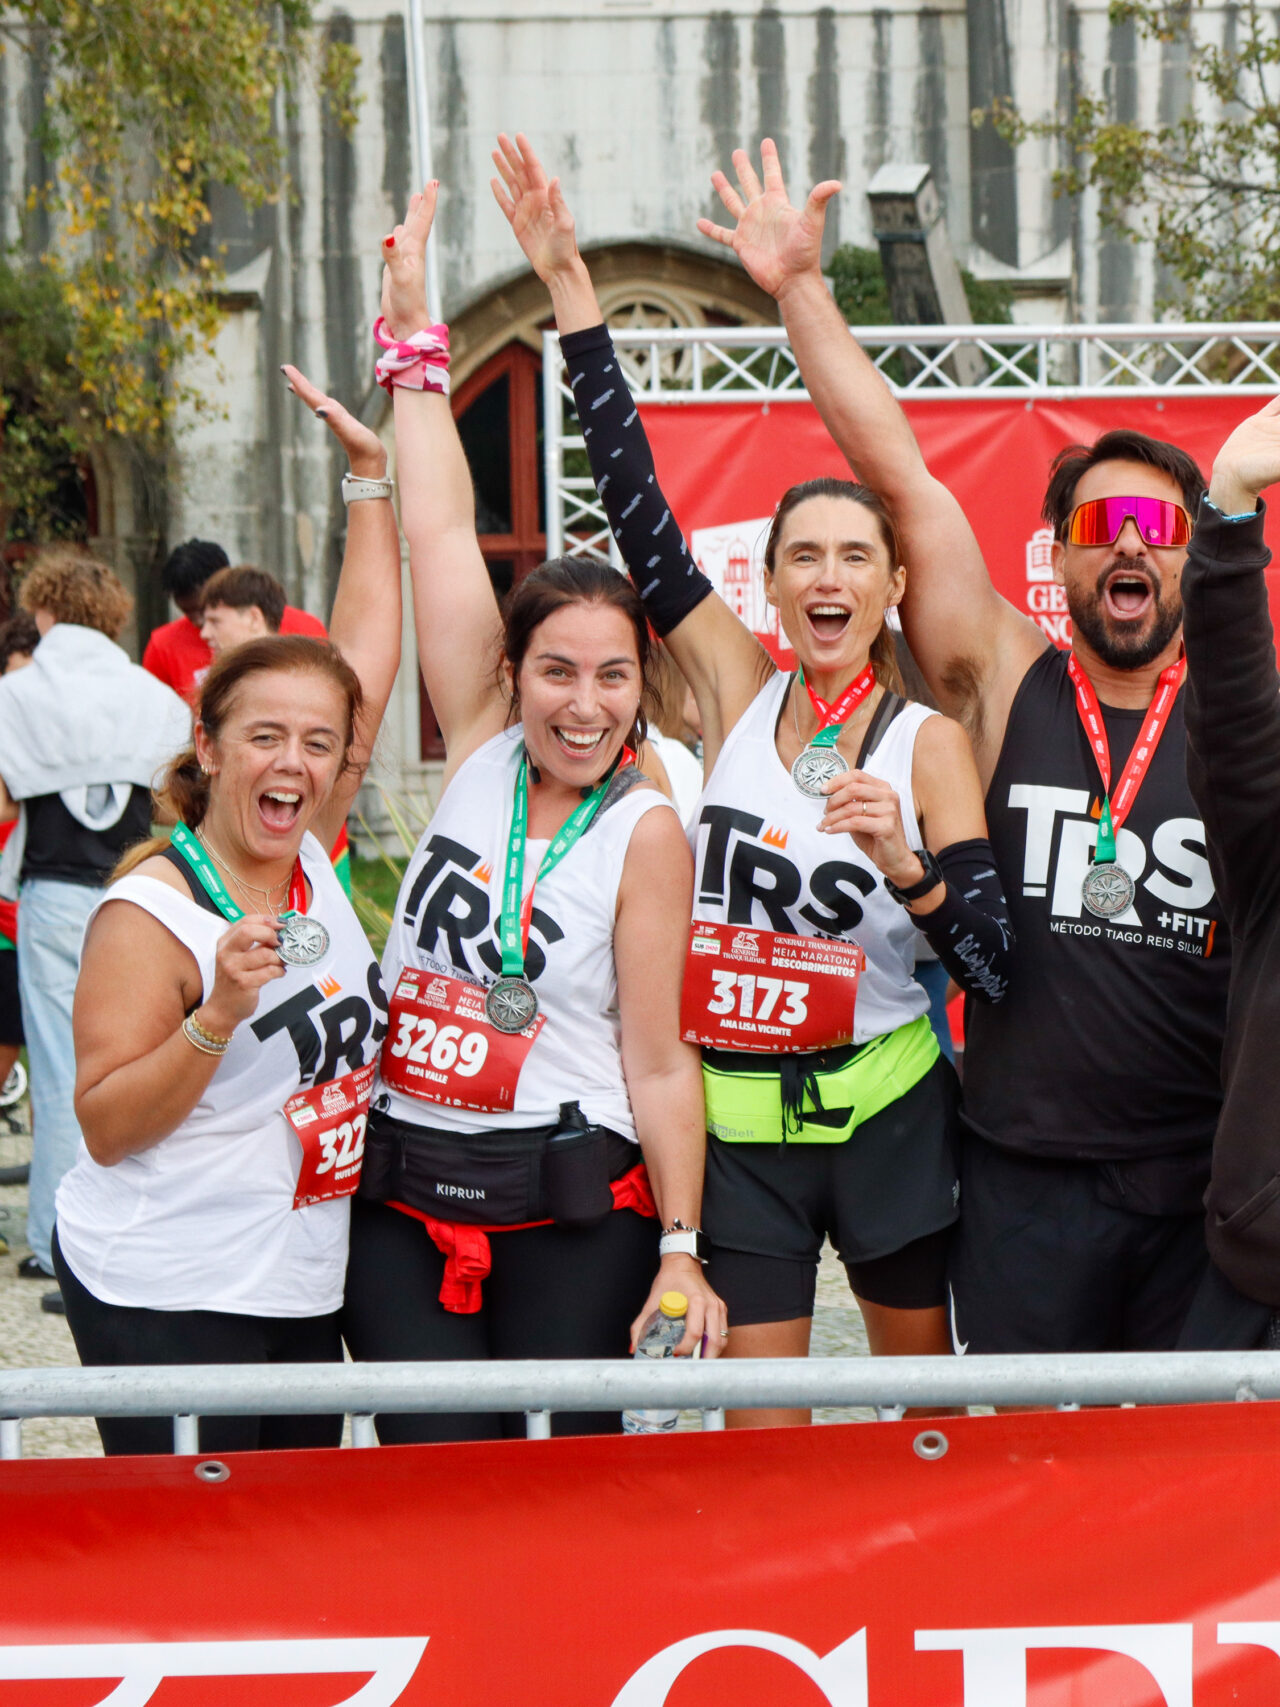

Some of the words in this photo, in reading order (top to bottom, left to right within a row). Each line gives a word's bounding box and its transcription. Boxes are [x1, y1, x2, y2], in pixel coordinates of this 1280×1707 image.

[699, 804, 878, 935] TRS
[1007, 783, 1216, 928] TRS
[403, 834, 566, 984] TRS
[774, 936, 806, 948] GENERALI
[807, 939, 859, 956] TRANQUILIDADE
[1050, 919, 1101, 937] MÉTODO
[1105, 927, 1143, 944] TIAGO
[1146, 934, 1174, 949] REIS
[1177, 940, 1203, 957] SILVA
[771, 956, 856, 978] DESCOBRIMENTOS
[772, 947, 798, 959] MEIA
[800, 950, 857, 967] MARATONA
[458, 995, 482, 1010] MEIA
[706, 968, 810, 1026] 3173
[719, 1018, 738, 1030] ANA
[738, 1021, 757, 1033] LISA
[757, 1023, 792, 1037] VICENTE
[390, 1011, 489, 1078] 3269
[425, 1069, 449, 1085] VALLE
[316, 1113, 368, 1175] 322
[436, 1182, 486, 1200] KIPRUN
